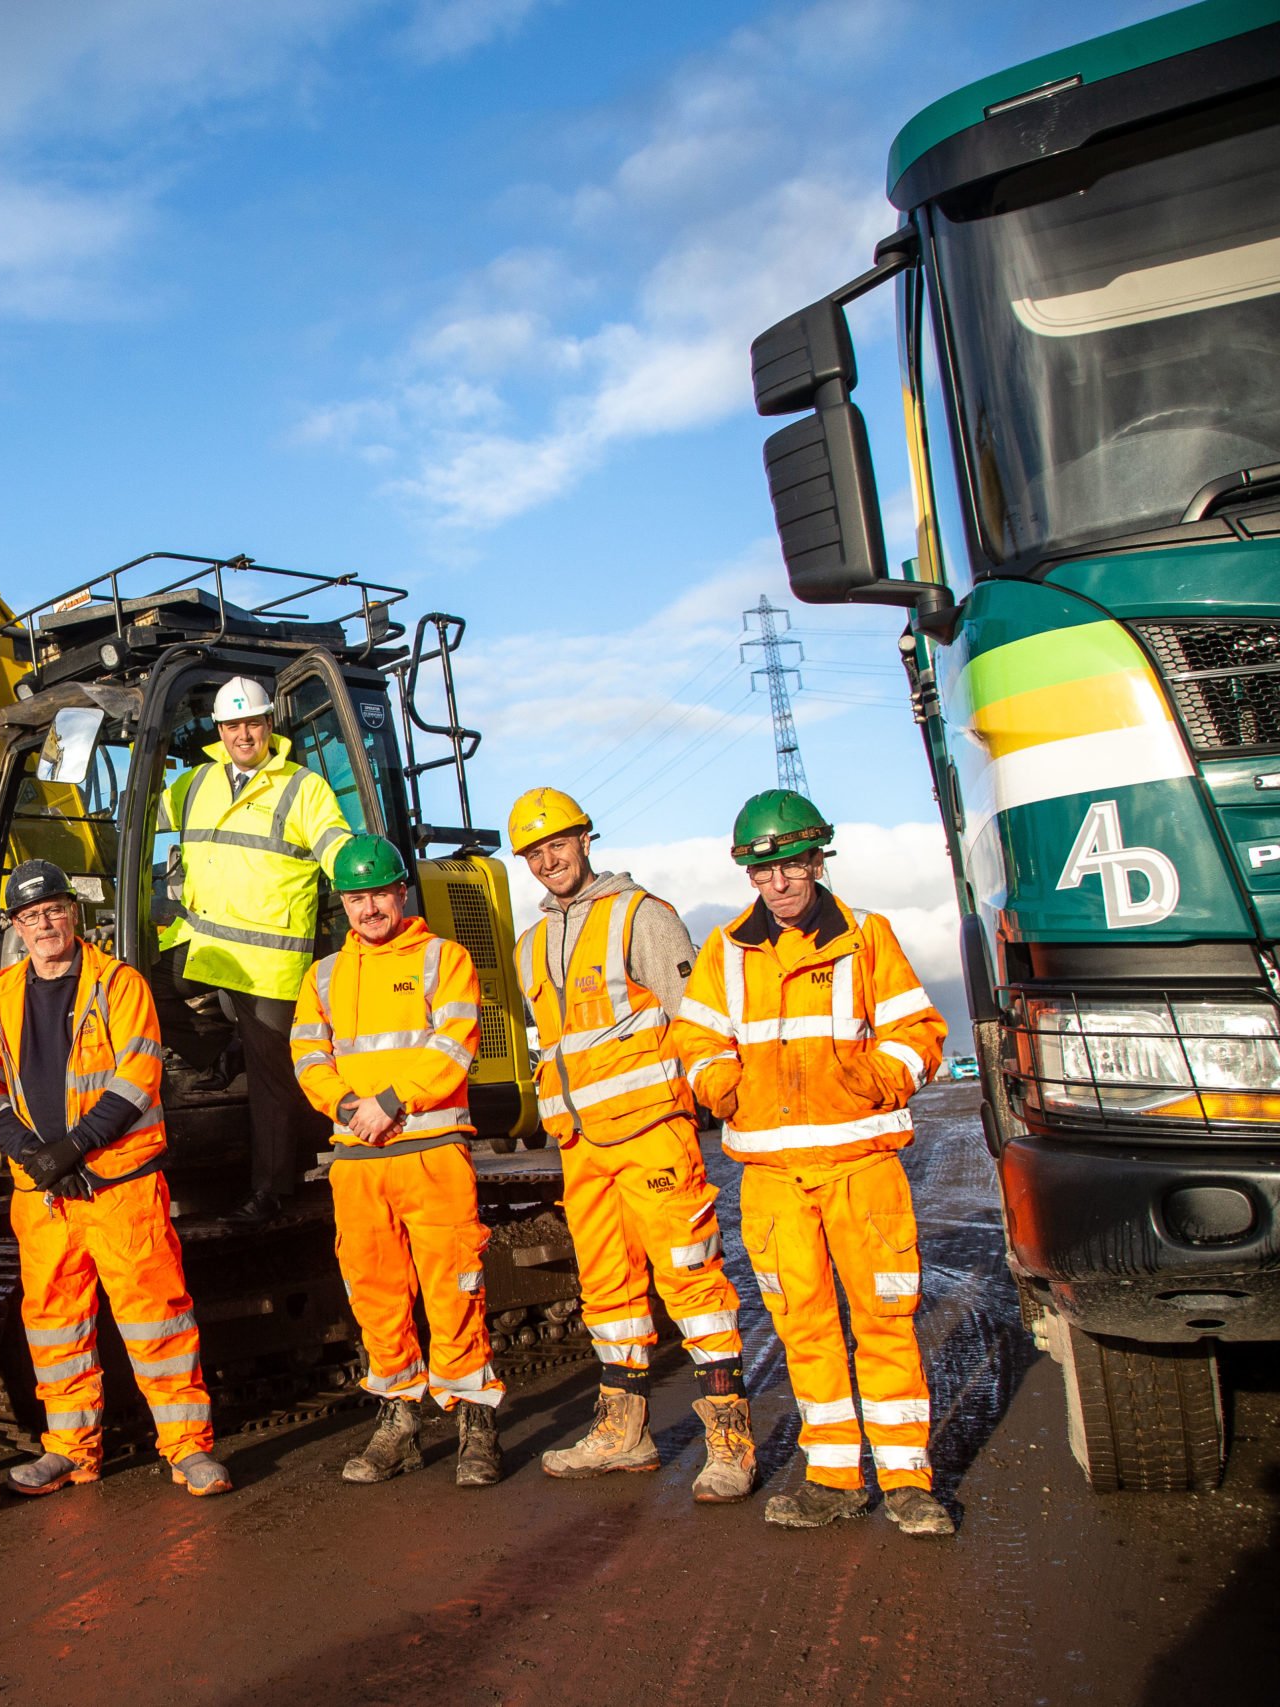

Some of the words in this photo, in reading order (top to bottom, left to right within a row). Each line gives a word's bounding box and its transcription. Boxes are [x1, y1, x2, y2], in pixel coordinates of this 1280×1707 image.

[1055, 799, 1180, 929] AD
[575, 975, 597, 988] MGL
[811, 972, 833, 984] MG
[394, 982, 415, 992] MGL
[647, 1177, 674, 1189] MGL
